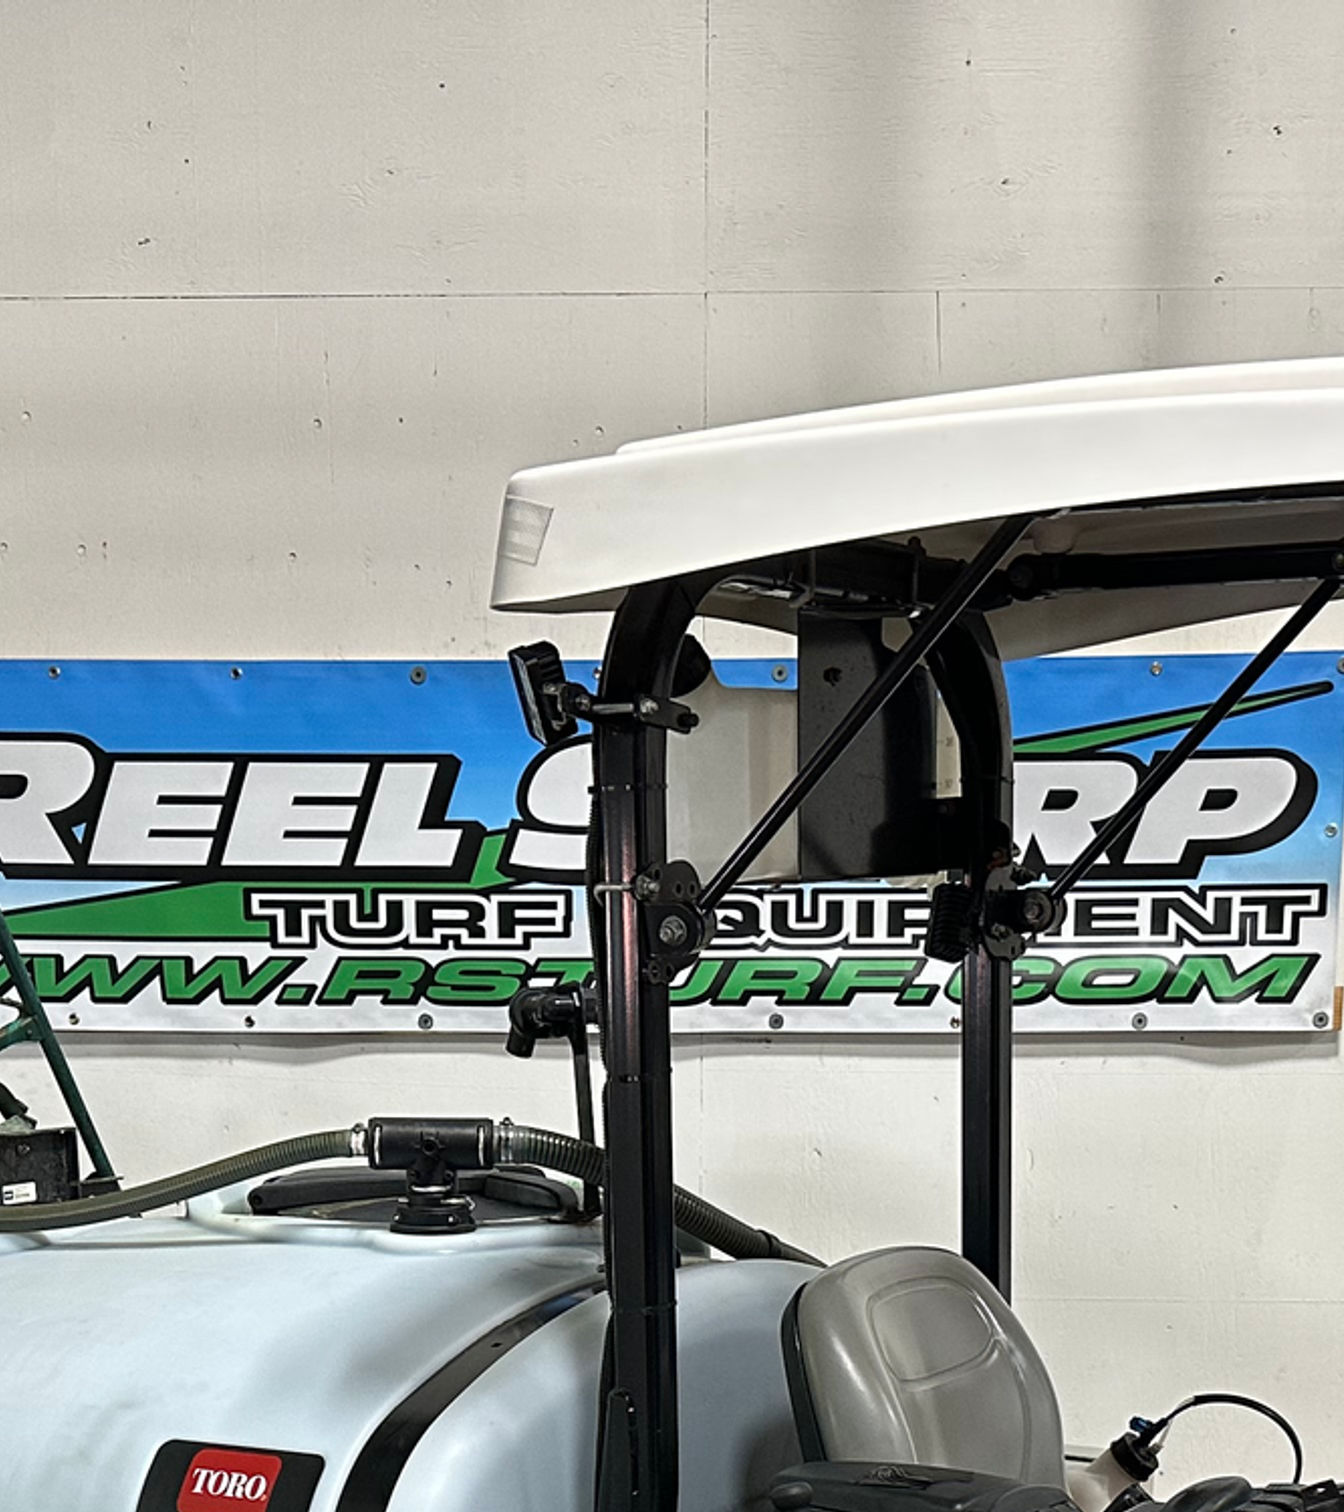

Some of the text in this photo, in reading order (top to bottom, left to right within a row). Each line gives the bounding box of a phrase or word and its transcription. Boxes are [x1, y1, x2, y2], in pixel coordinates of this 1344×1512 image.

[507, 735, 1311, 876] SRP
[247, 886, 1327, 947] TURF QUIPENT
[192, 1467, 266, 1500] TORO
